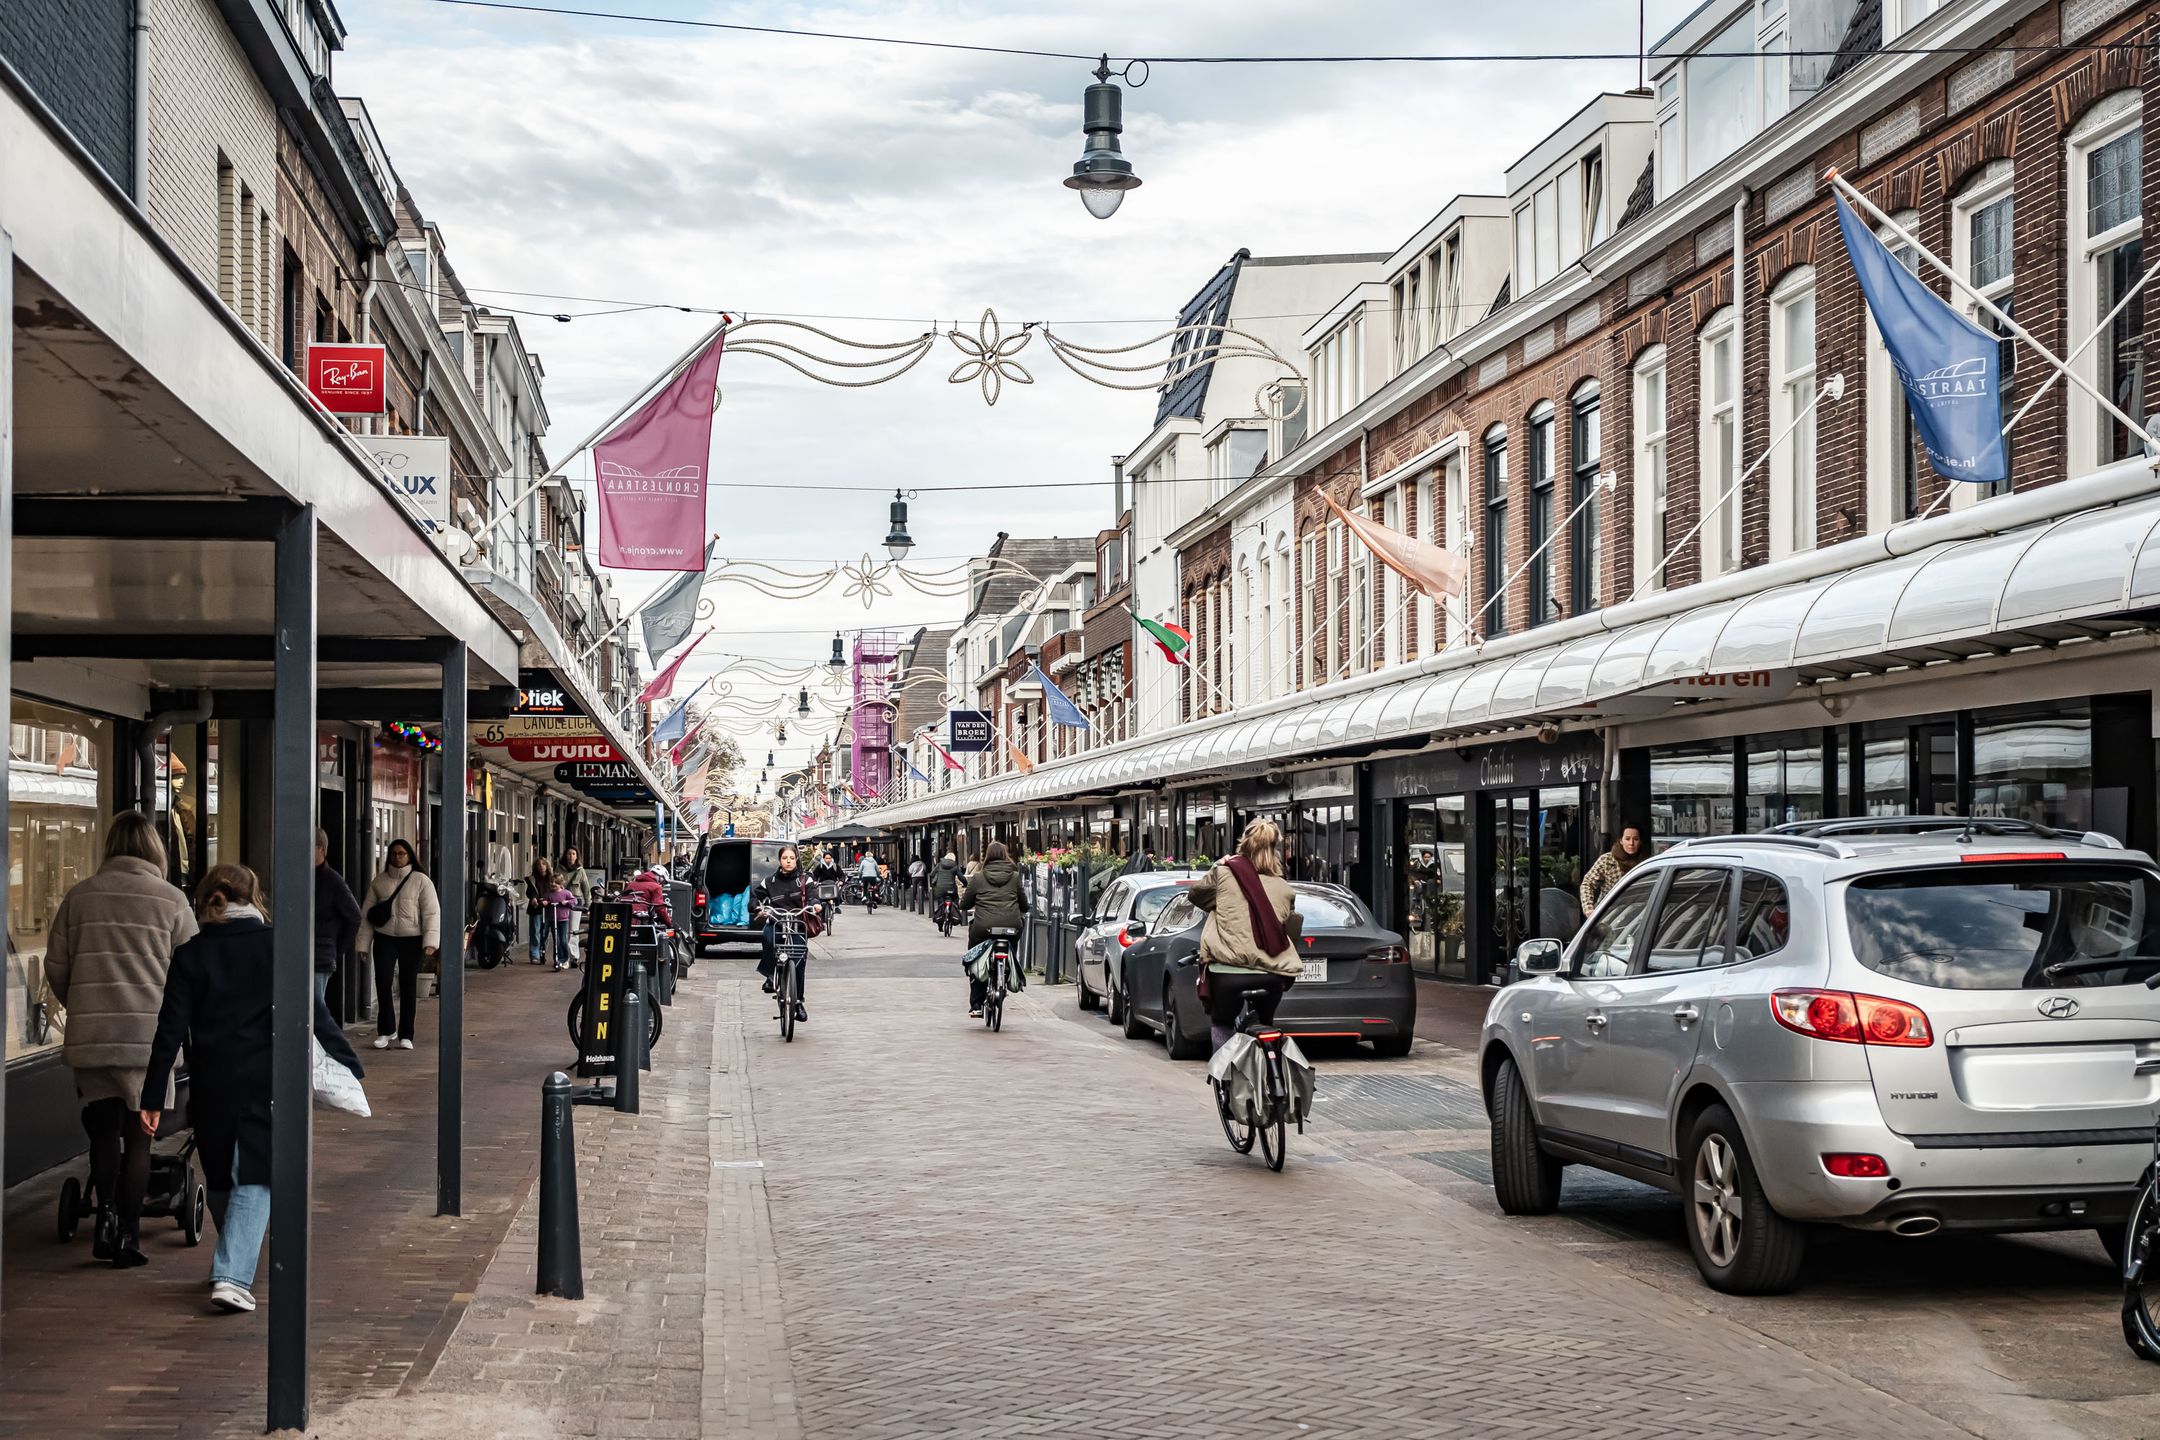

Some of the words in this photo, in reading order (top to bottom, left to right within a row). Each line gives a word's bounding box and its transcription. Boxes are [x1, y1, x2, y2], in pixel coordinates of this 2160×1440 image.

[323, 362, 369, 386] Ray-Ban
[1672, 670, 1771, 688] aren
[486, 725, 505, 742] 65
[605, 914, 618, 922] ELKE
[596, 935, 615, 1040] OPEN
[1890, 1092, 1938, 1100] HYUNDAI
